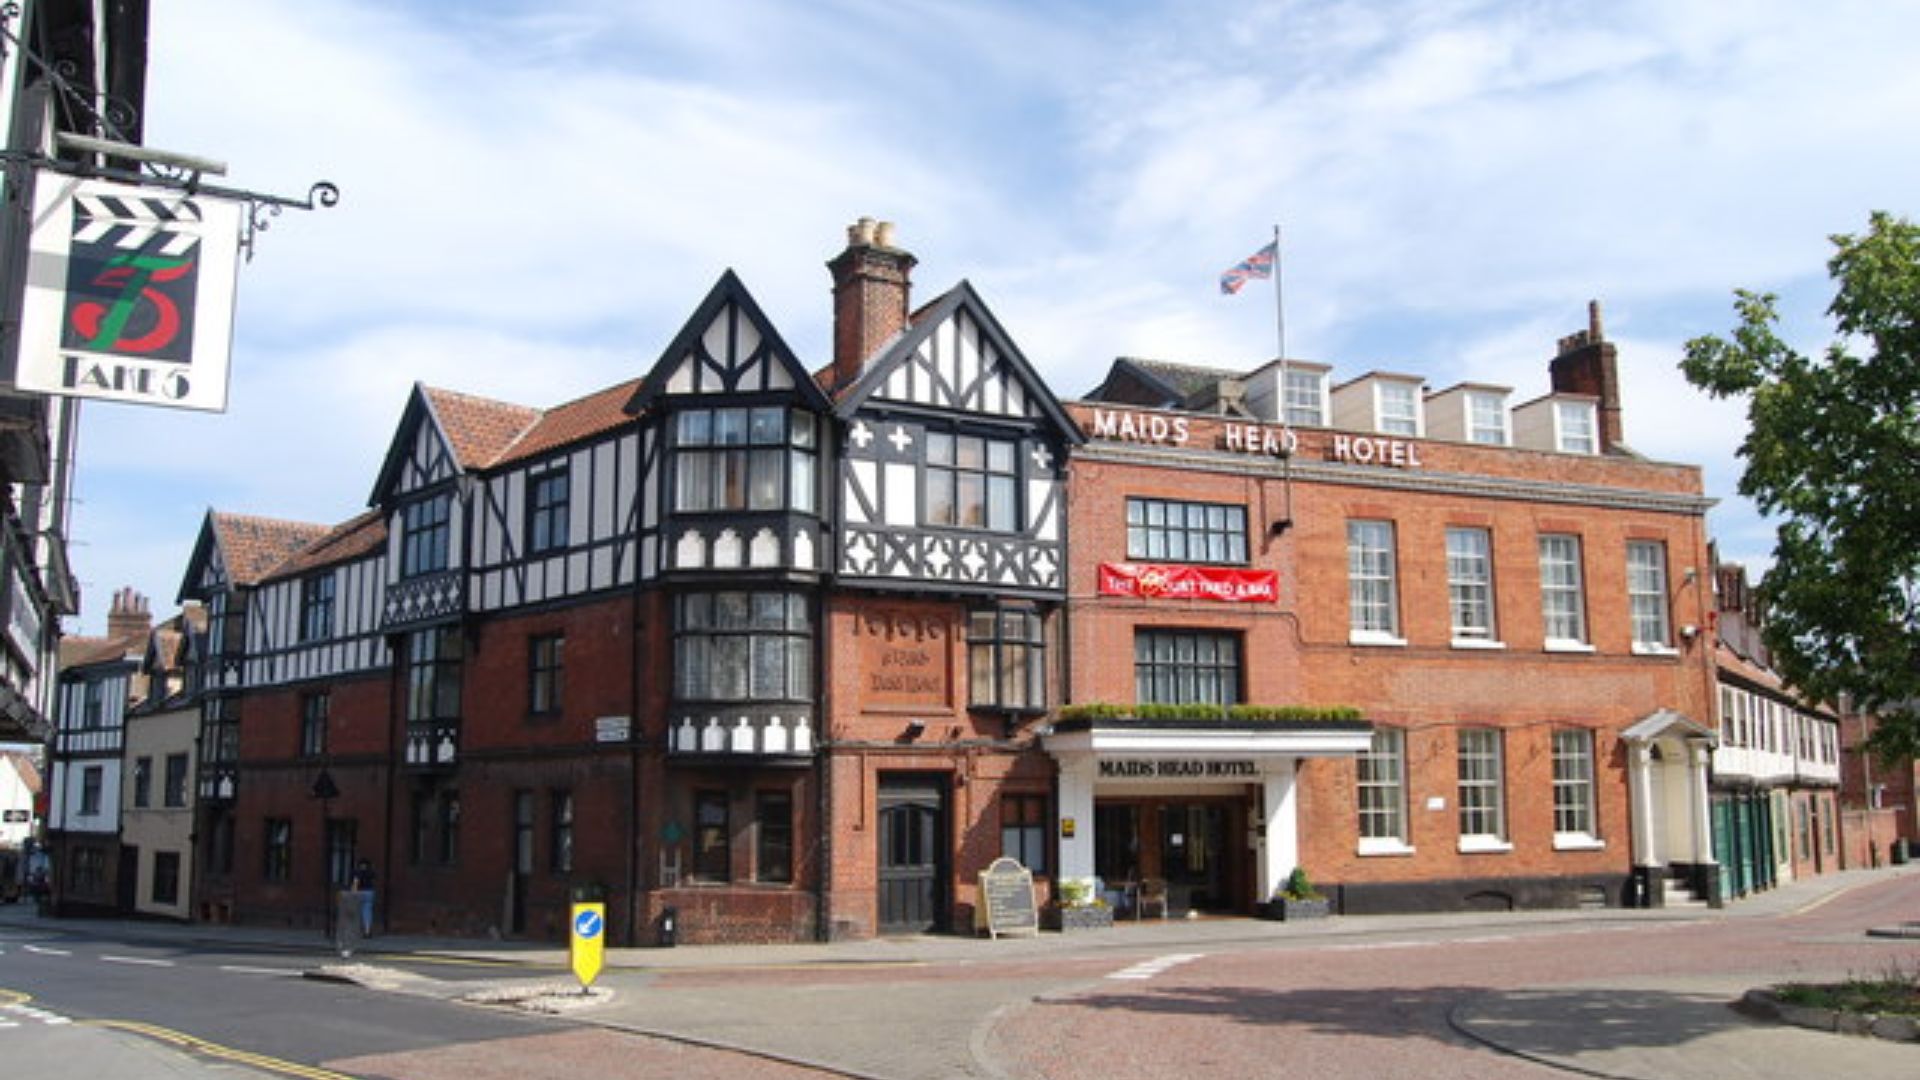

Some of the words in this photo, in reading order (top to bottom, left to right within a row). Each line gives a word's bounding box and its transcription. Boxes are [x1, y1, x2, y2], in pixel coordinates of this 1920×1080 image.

[60, 355, 158, 394] TAKE
[1094, 408, 1190, 442] MAIDS
[1225, 422, 1297, 453] HEAD
[1334, 434, 1421, 466] HOTEL
[1099, 760, 1155, 777] MAIDS
[1157, 760, 1204, 777] HEAD
[1206, 760, 1259, 776] HOTEL
